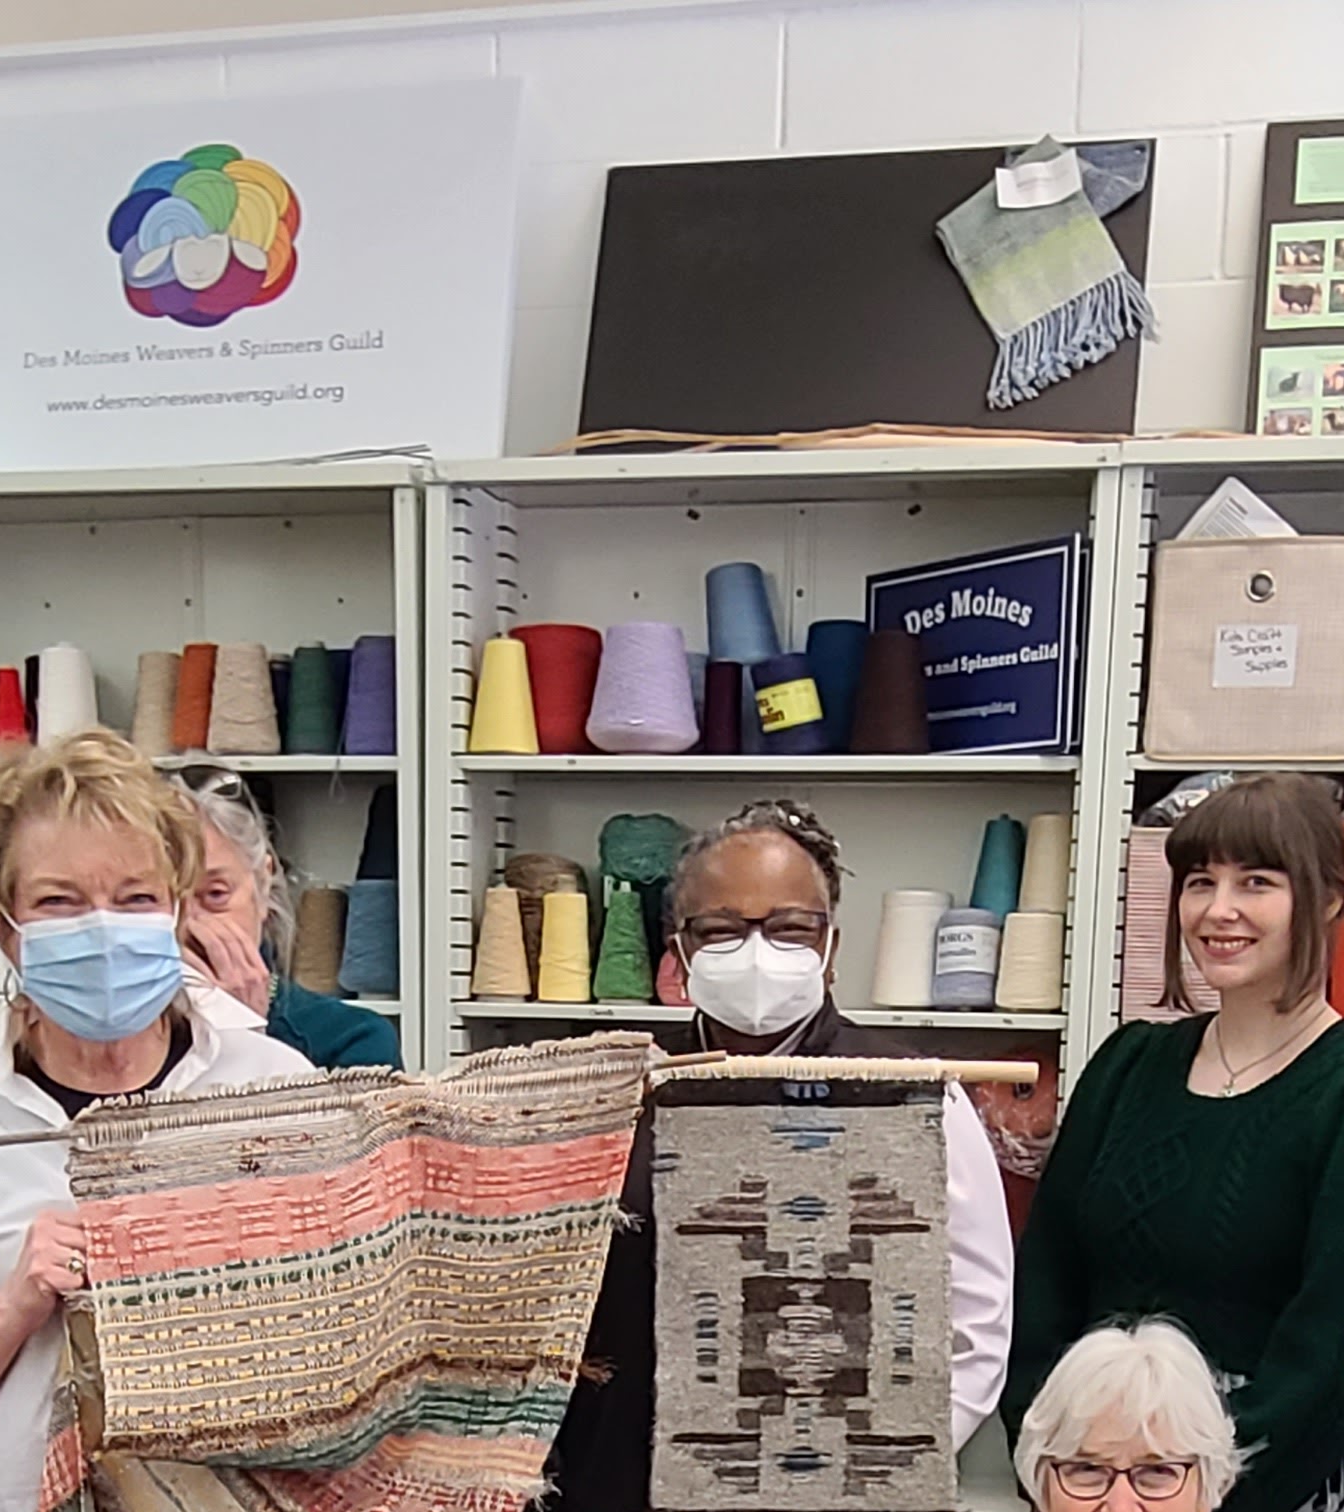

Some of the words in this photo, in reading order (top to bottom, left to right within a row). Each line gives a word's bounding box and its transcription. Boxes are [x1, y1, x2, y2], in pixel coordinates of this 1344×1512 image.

[24, 352, 56, 369] Des
[62, 349, 130, 368] Moines
[136, 345, 214, 362] Weavers
[219, 342, 233, 357] &
[239, 338, 323, 360] Spinners
[329, 330, 384, 351] Guild
[47, 384, 345, 413] www.desmoinesweaversguild.org
[904, 602, 945, 635] Des
[950, 587, 1033, 628] Moines
[934, 658, 959, 675] and
[960, 652, 1018, 675] Spinners
[1019, 643, 1059, 663] Guild
